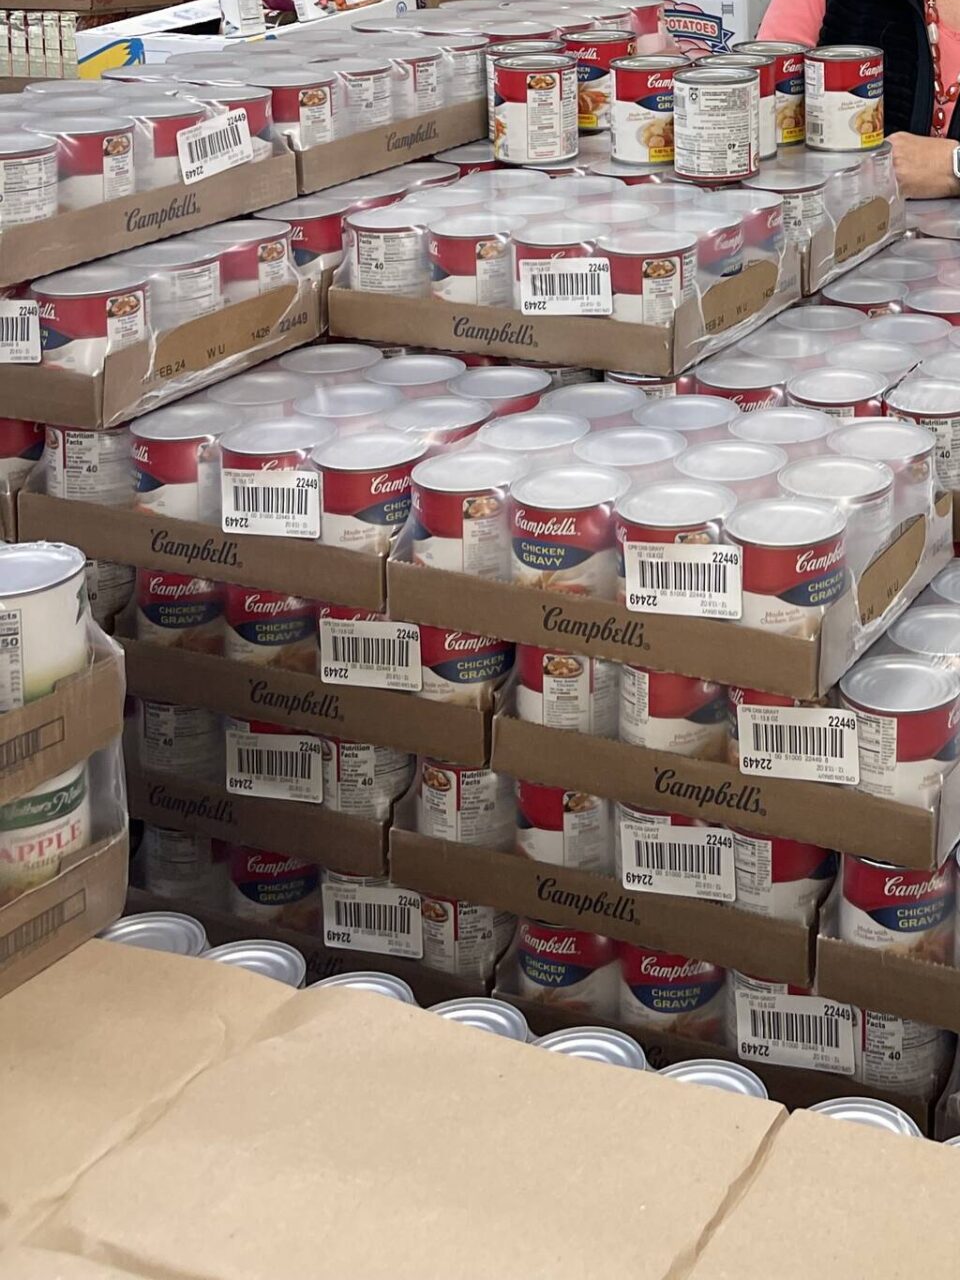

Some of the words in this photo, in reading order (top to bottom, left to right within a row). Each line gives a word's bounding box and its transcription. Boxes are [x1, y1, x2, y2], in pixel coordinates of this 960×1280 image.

[227, 113, 246, 127] 22449
[386, 120, 439, 152] Campbell's
[185, 166, 204, 180] 22449
[124, 192, 200, 232] Campbell's
[374, 262, 384, 270] 40
[588, 263, 609, 273] 22449
[19, 306, 38, 317] 22449
[524, 301, 547, 310] 22449
[279, 312, 308, 334] 22449
[452, 316, 538, 347] Campbell's
[154, 363, 173, 378] FEB
[174, 359, 186, 372] 24
[207, 345, 216, 358] W
[217, 344, 226, 355] U
[251, 326, 271, 341] 1426
[940, 450, 950, 458] 40
[86, 465, 98, 473] 40
[296, 477, 318, 490] 22449
[225, 517, 249, 528] 22449
[515, 509, 577, 536] Campbell's
[150, 528, 238, 568] Campbell's
[521, 542, 565, 556] CHICKEN
[522, 552, 563, 567] GRAVY
[712, 552, 739, 566] 22449
[629, 594, 657, 607] 22449
[541, 604, 645, 648] Campbell's
[396, 628, 419, 642] 22449
[457, 654, 505, 670] CHICKEN
[324, 666, 349, 679] 22449
[458, 664, 502, 680] GRAVY
[250, 679, 340, 719] Campbell's
[828, 716, 856, 730] 22449
[162, 738, 173, 747] 40
[299, 741, 321, 755] 22449
[743, 756, 772, 770] 22449
[229, 777, 253, 790] 22449
[361, 778, 374, 787] 40
[655, 767, 761, 813] Campbell's
[150, 784, 234, 822] Campbell's
[483, 802, 496, 811] 40
[706, 834, 732, 848] 22449
[625, 872, 653, 886] 22449
[398, 895, 420, 909] 22449
[537, 874, 635, 922] Campbell's
[896, 900, 946, 918] CHICKEN
[898, 912, 942, 928] GRAVY
[327, 931, 351, 943] 22449
[480, 931, 493, 940] 40
[519, 923, 577, 955] Campbell's
[525, 956, 567, 974] CHICKEN
[526, 967, 564, 984] GRAVY
[651, 988, 702, 998] CHICKEN
[652, 998, 699, 1008] GRAVY
[823, 1004, 851, 1021] 22449
[866, 1021, 886, 1029] Facts
[741, 1042, 770, 1057] 22449
[888, 1052, 901, 1061] 40
